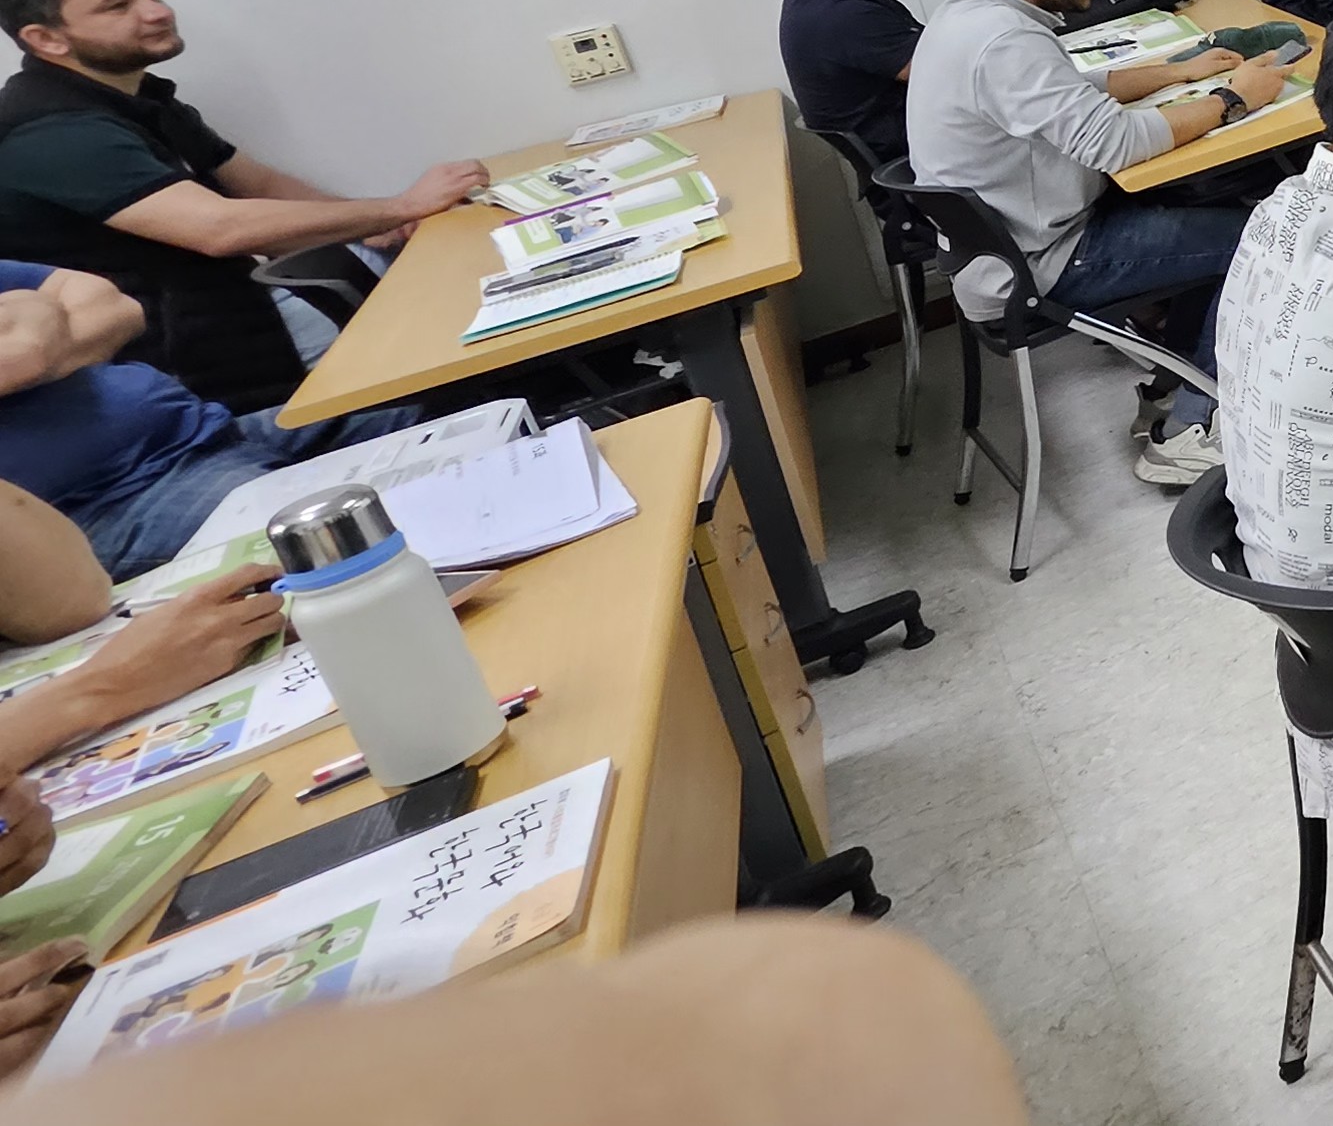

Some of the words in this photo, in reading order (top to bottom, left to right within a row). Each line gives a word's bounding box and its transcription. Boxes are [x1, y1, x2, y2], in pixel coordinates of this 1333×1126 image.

[1323, 502, 1333, 545] modal
[134, 814, 185, 847] 15
[480, 799, 548, 890] 한국어와
[400, 827, 481, 925] 한국문화
